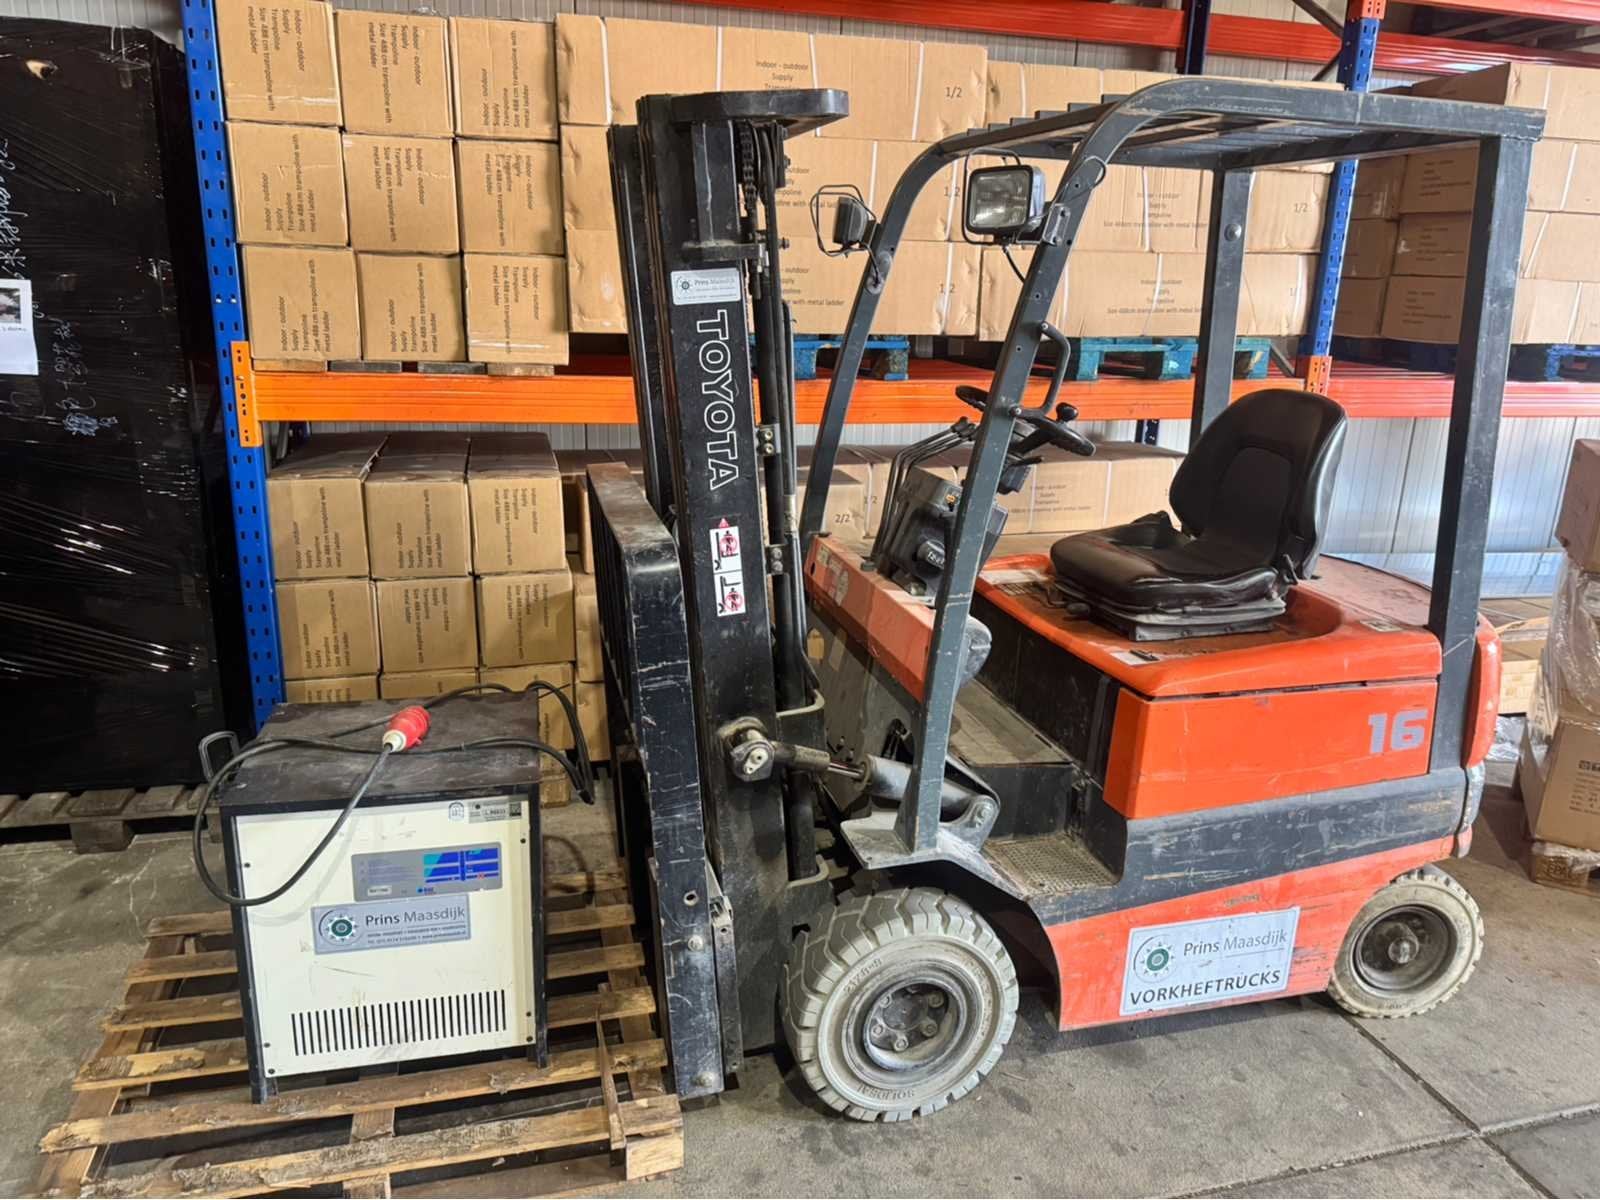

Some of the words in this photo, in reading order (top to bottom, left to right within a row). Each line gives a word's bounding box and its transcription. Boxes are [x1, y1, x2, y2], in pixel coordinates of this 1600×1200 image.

[248, 6, 256, 28] metal
[282, 9, 290, 33] Supply
[272, 9, 280, 50] Trampoline
[401, 25, 409, 48] Supply
[250, 30, 258, 54] ladder
[263, 40, 269, 51] cm
[391, 24, 399, 65] Trampoline
[297, 41, 305, 71] outdoor
[382, 55, 388, 66] cm
[264, 53, 273, 92] trampoline
[414, 56, 422, 85] outdoor
[382, 67, 390, 106] trampoline
[513, 88, 519, 98] cm
[521, 85, 529, 107] ladder
[945, 86, 962, 98] 1/2
[268, 95, 276, 111] with
[492, 104, 500, 127] Supply
[944, 187, 960, 197] 12
[1294, 203, 1308, 213] 1/2
[504, 293, 510, 304] cm
[939, 284, 955, 294] 12
[312, 313, 318, 323] cm
[420, 316, 426, 326] cm
[291, 329, 299, 352] Supply
[696, 309, 739, 491] TOYOTA
[834, 513, 850, 524] 2/2
[1368, 709, 1428, 754] 16
[365, 913, 400, 927] Prins
[403, 906, 465, 923] Maasdijk
[1183, 941, 1220, 957] Prins
[1223, 929, 1288, 950] Maasdijk
[1130, 970, 1281, 1006] VORKHEFTRUCKS
